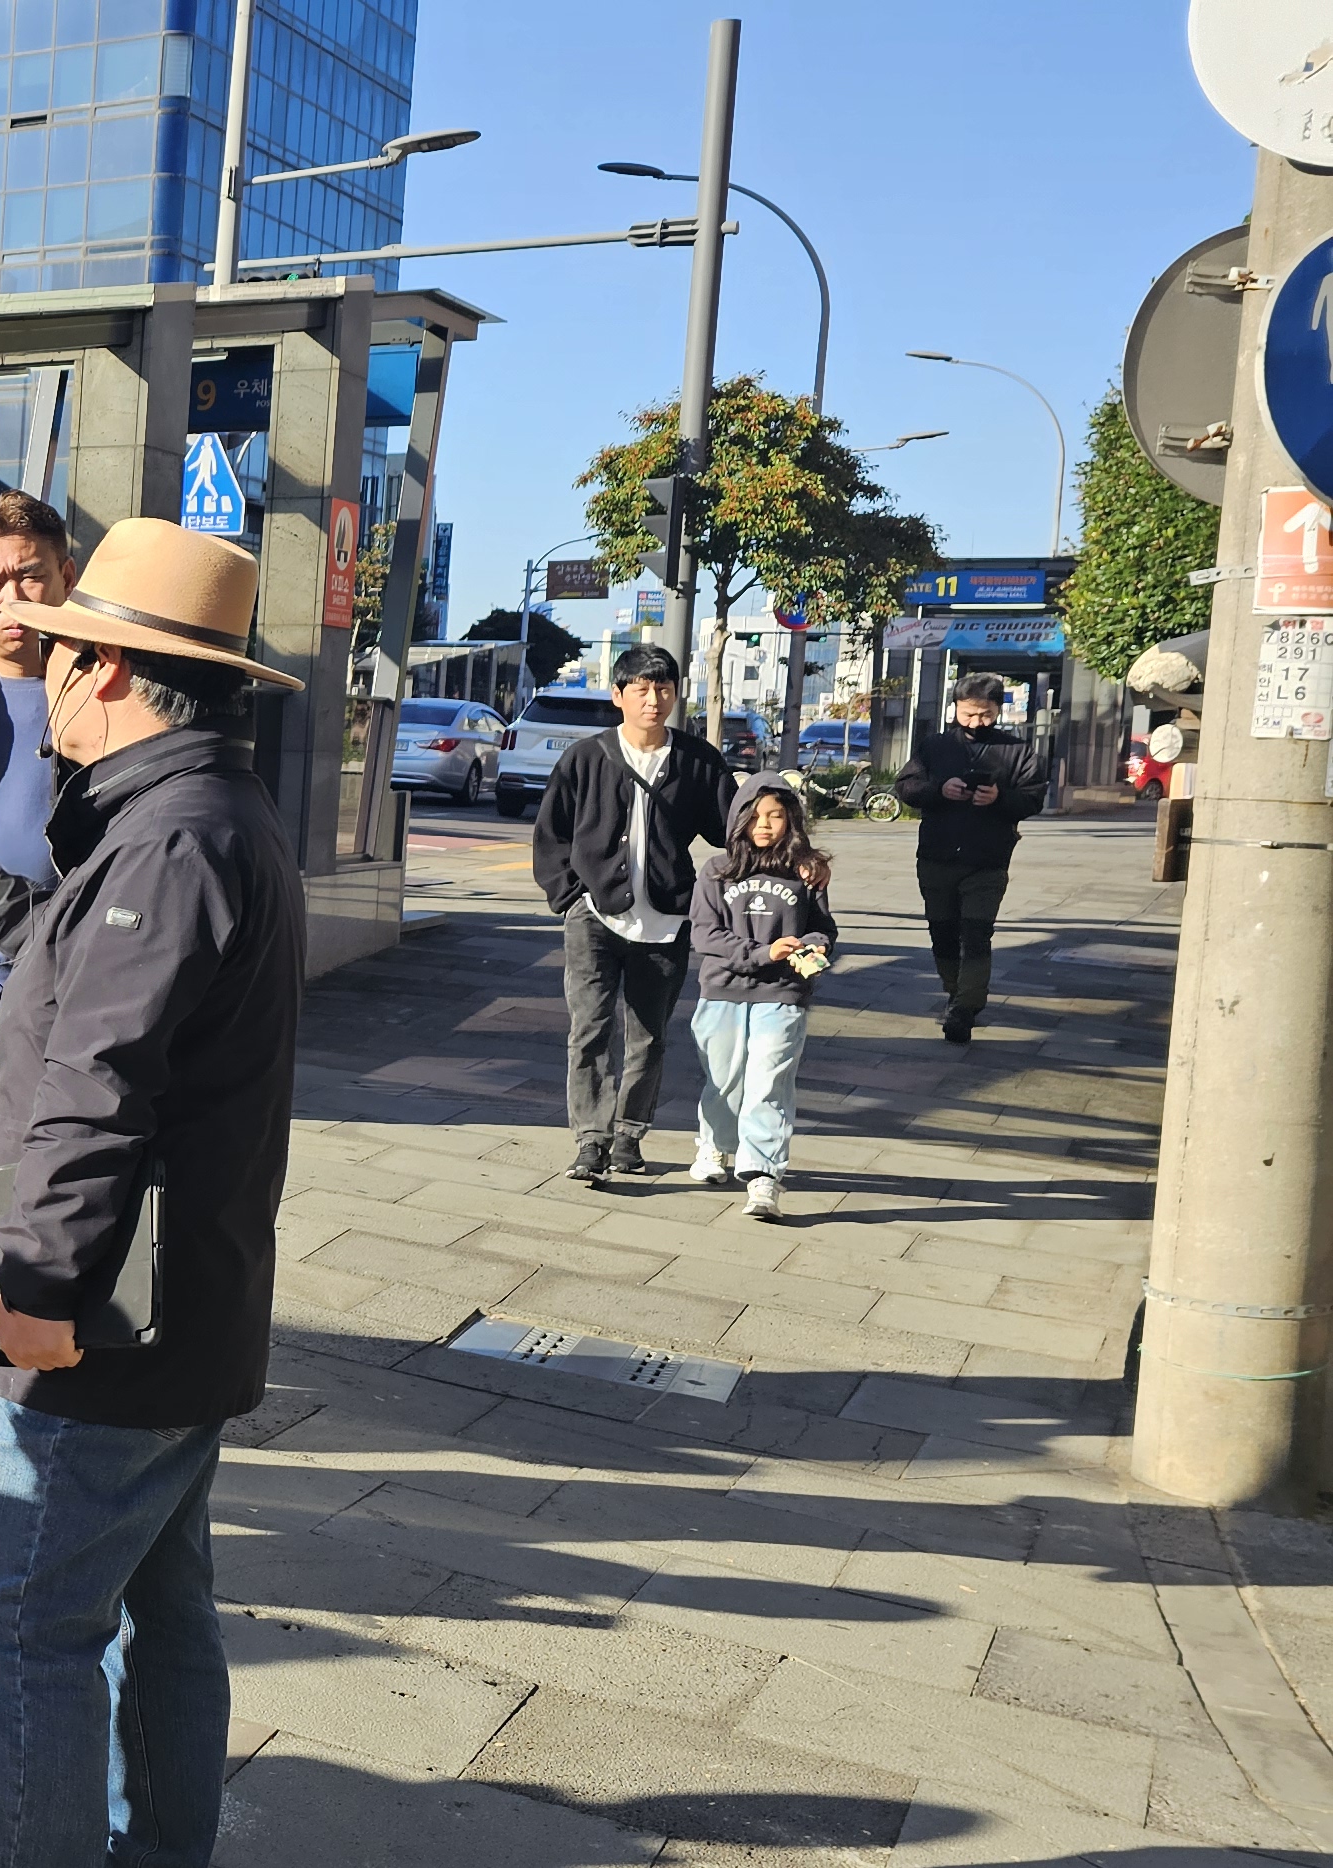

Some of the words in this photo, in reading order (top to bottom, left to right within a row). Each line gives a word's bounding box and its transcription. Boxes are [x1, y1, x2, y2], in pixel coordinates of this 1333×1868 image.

[196, 378, 217, 412] 9
[233, 378, 272, 399] 우체
[182, 514, 230, 530] 단보도
[904, 582, 932, 593] ATE
[935, 575, 958, 597] 11
[984, 621, 1058, 631] COUPON
[985, 631, 1057, 643] STORE
